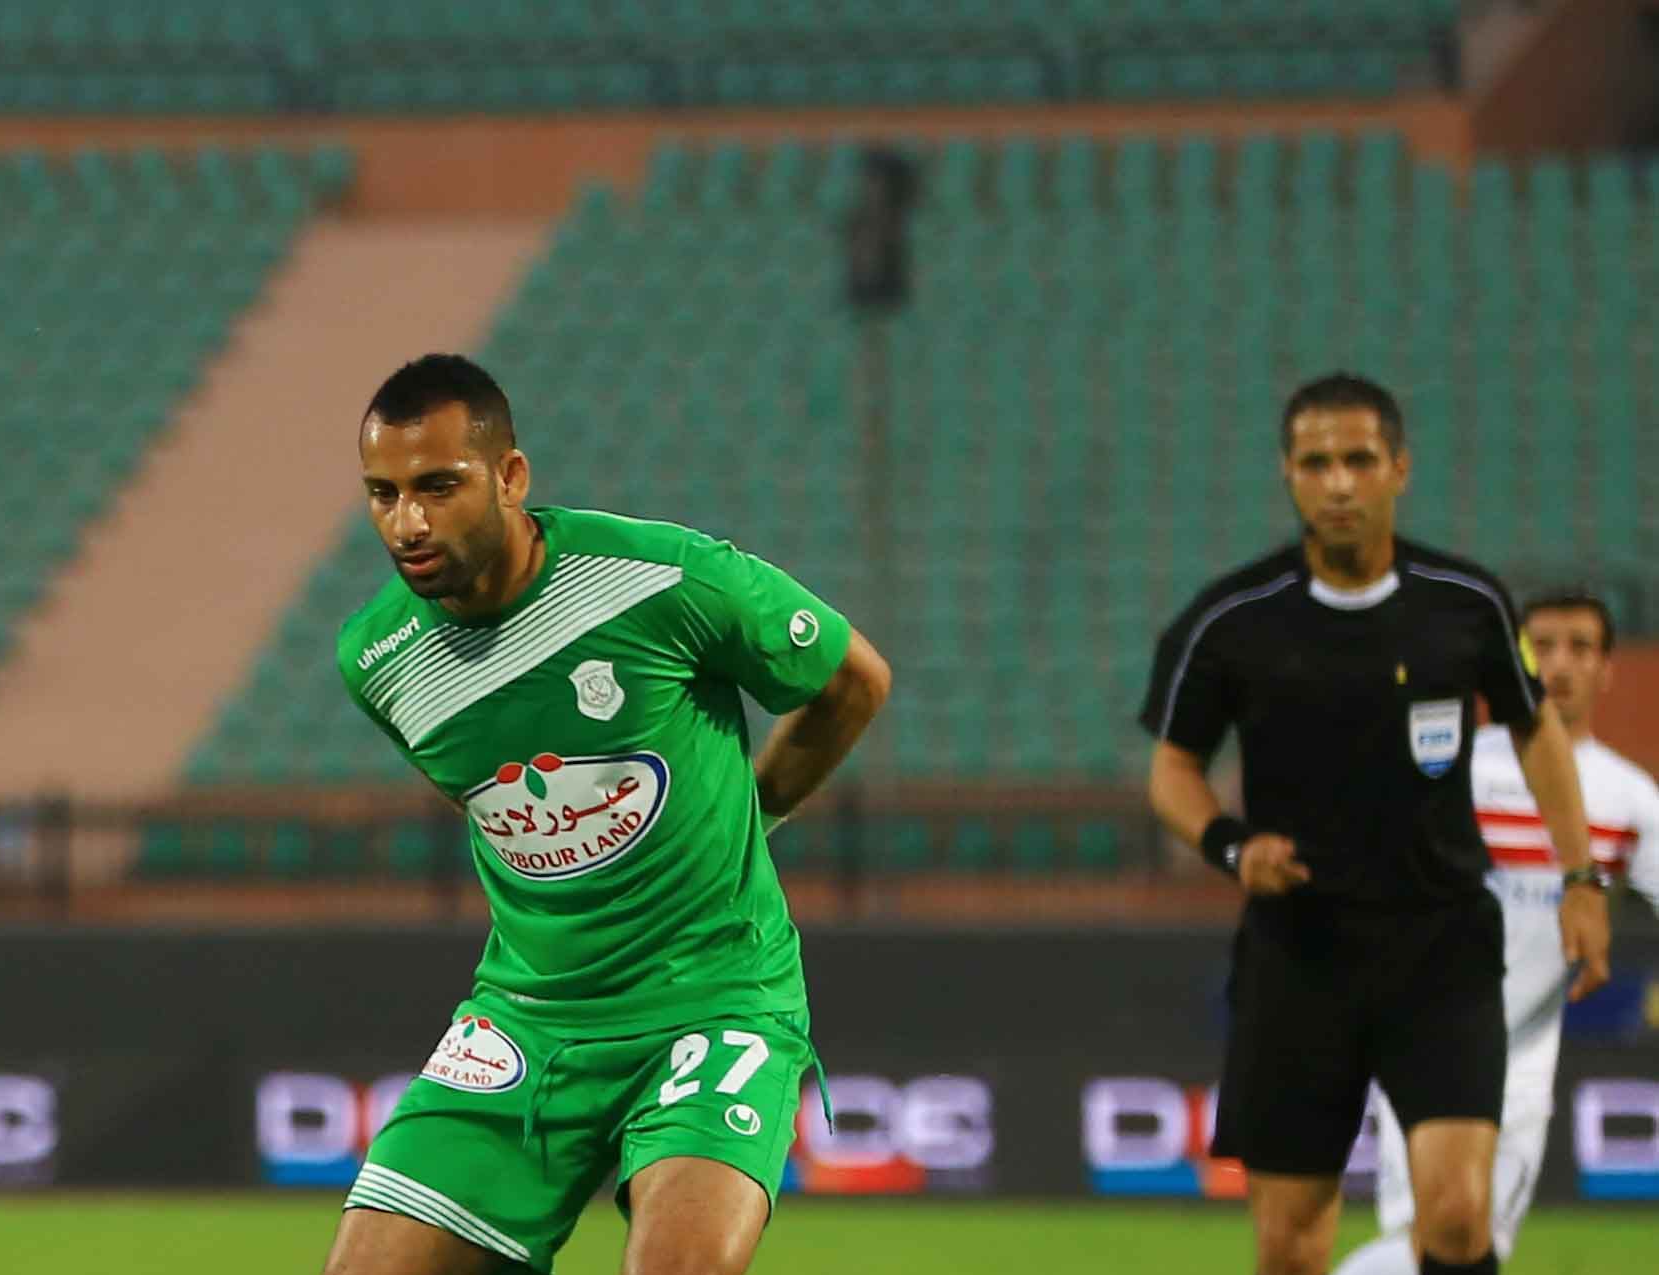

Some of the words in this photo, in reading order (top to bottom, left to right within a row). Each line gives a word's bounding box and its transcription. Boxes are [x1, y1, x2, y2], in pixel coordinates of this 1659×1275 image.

[356, 615, 421, 671] uhlsport
[580, 811, 643, 859] LAND
[453, 1069, 493, 1086] LAND
[658, 1029, 770, 1106] 27
